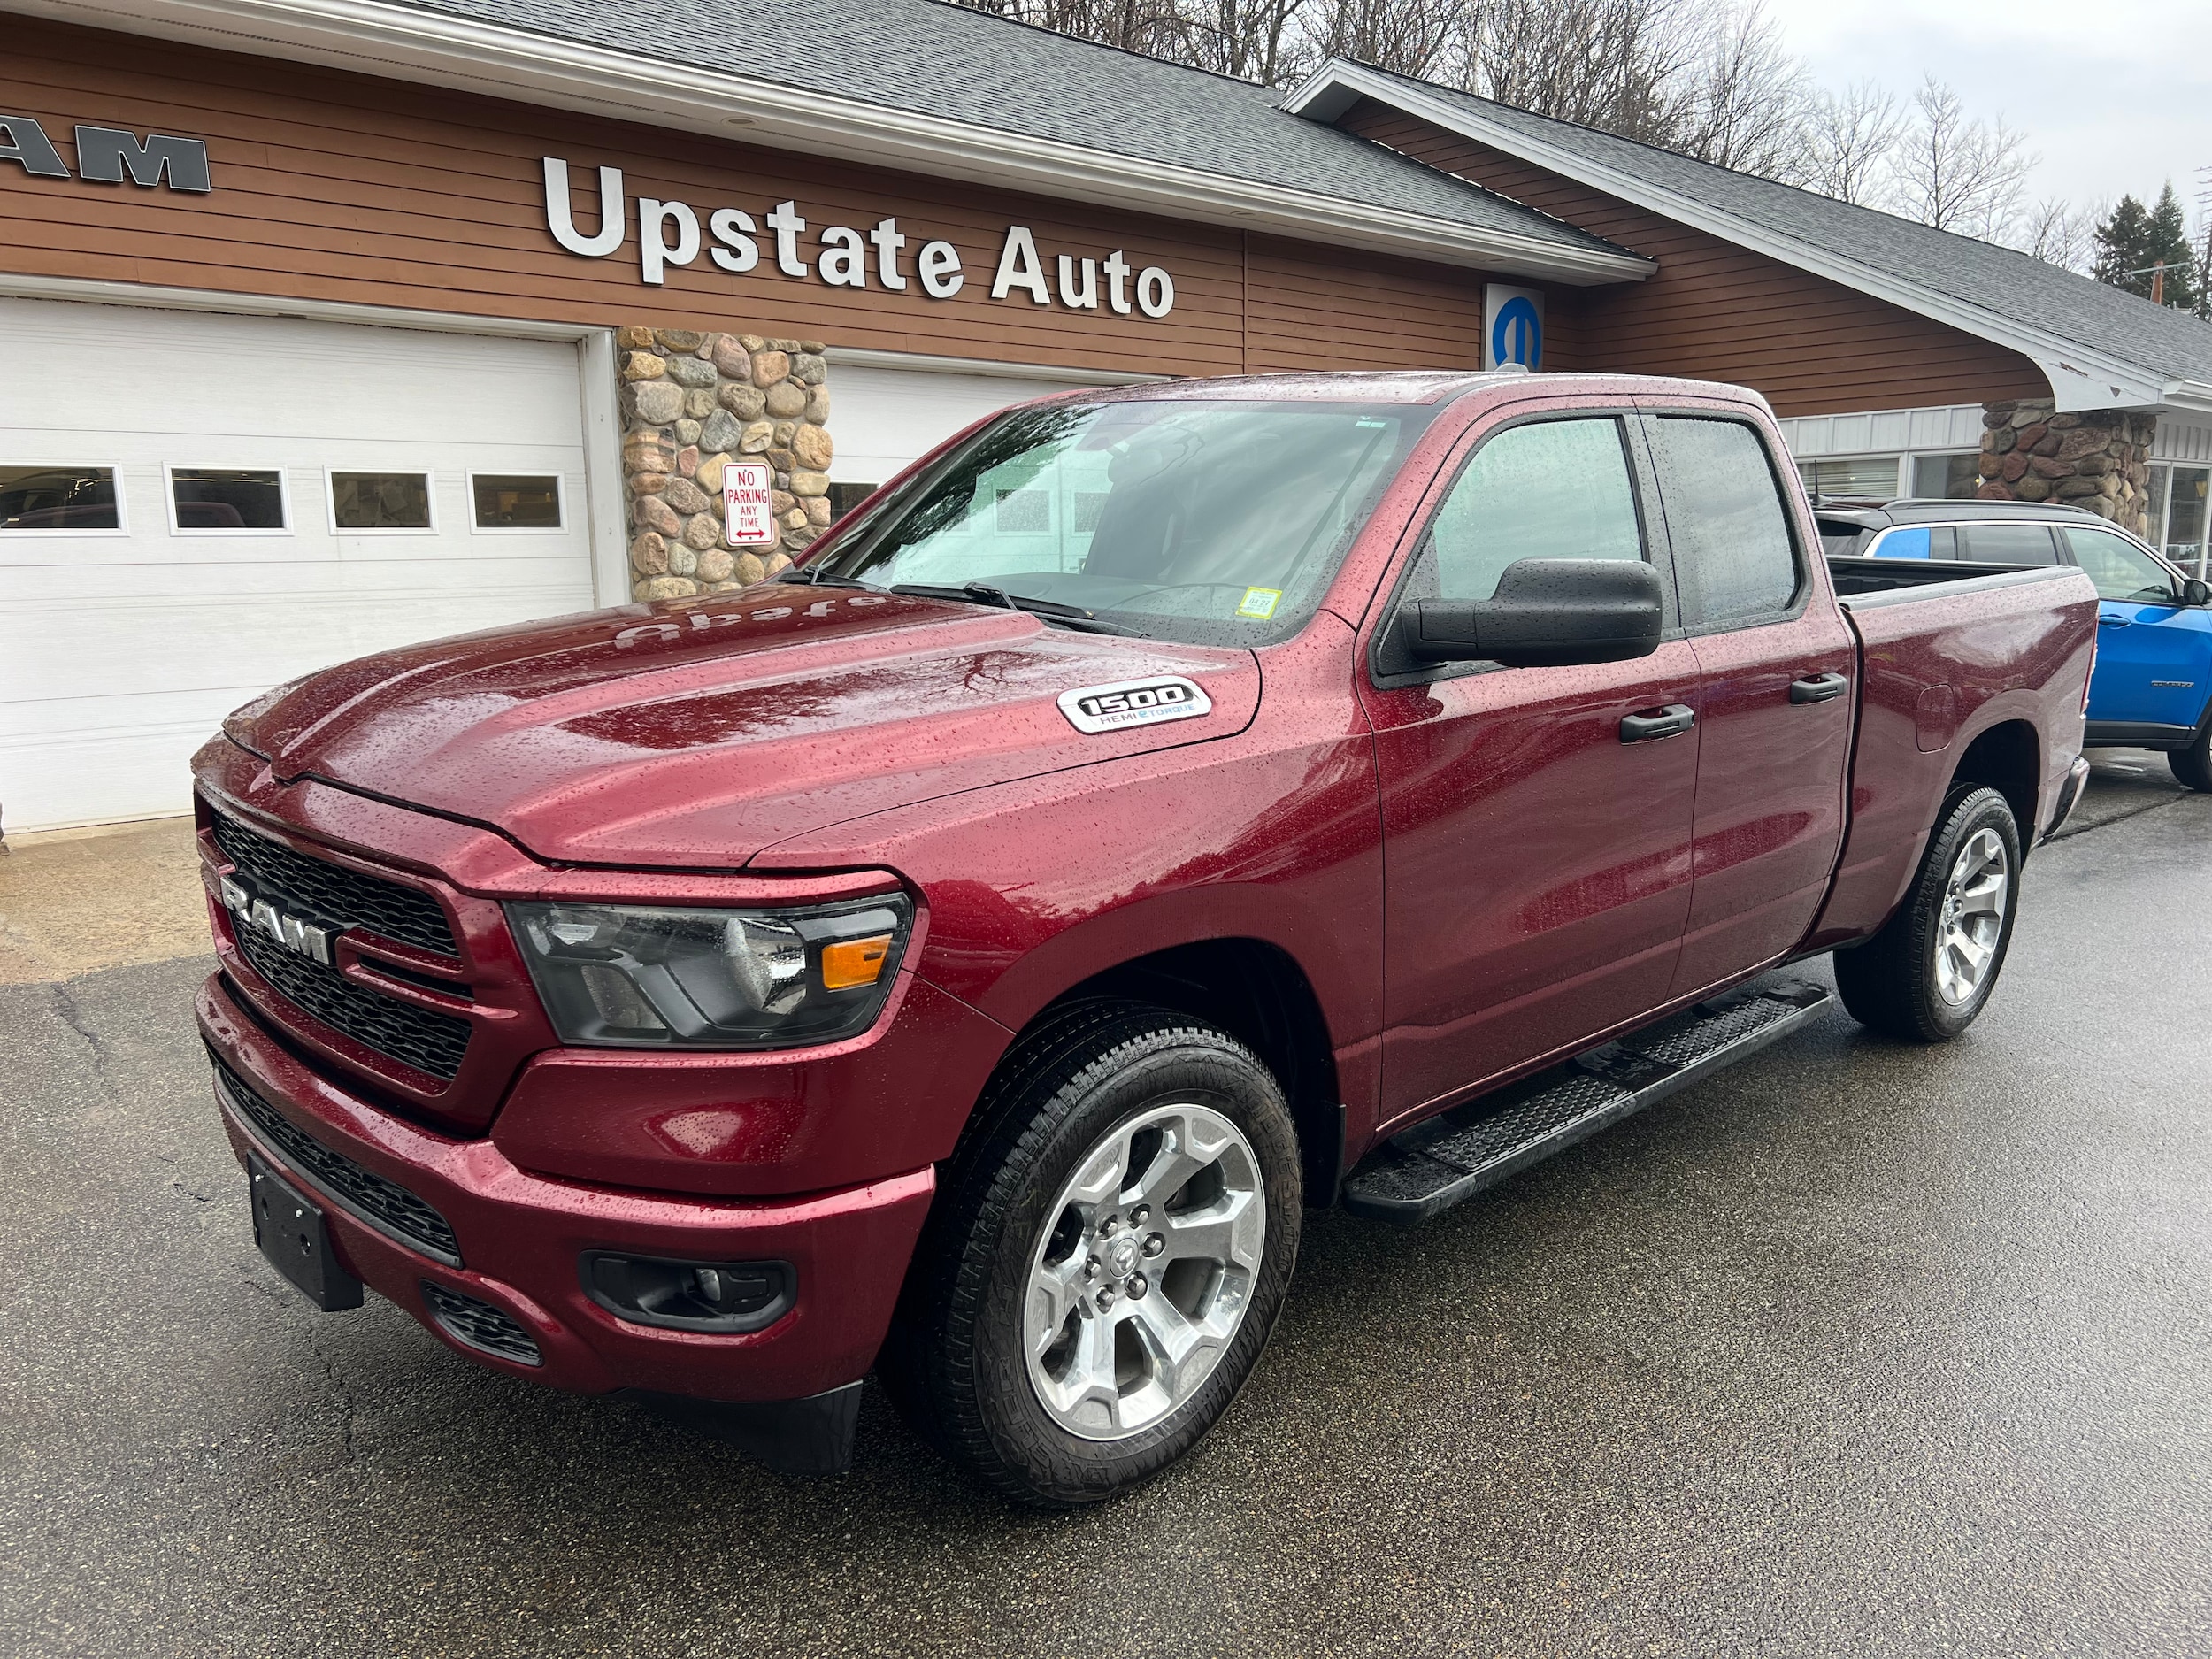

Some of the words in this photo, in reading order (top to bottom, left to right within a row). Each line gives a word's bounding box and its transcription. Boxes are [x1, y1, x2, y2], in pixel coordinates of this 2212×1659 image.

[542, 157, 965, 299] Upstate
[991, 225, 1175, 319] Auto
[738, 471, 755, 486] NO
[728, 489, 767, 503] PARKING
[740, 506, 757, 515] ANY
[740, 518, 760, 527] TIME
[1081, 686, 1186, 716] 1500
[1099, 712, 1138, 725] HEMI
[220, 877, 330, 965] RAM
